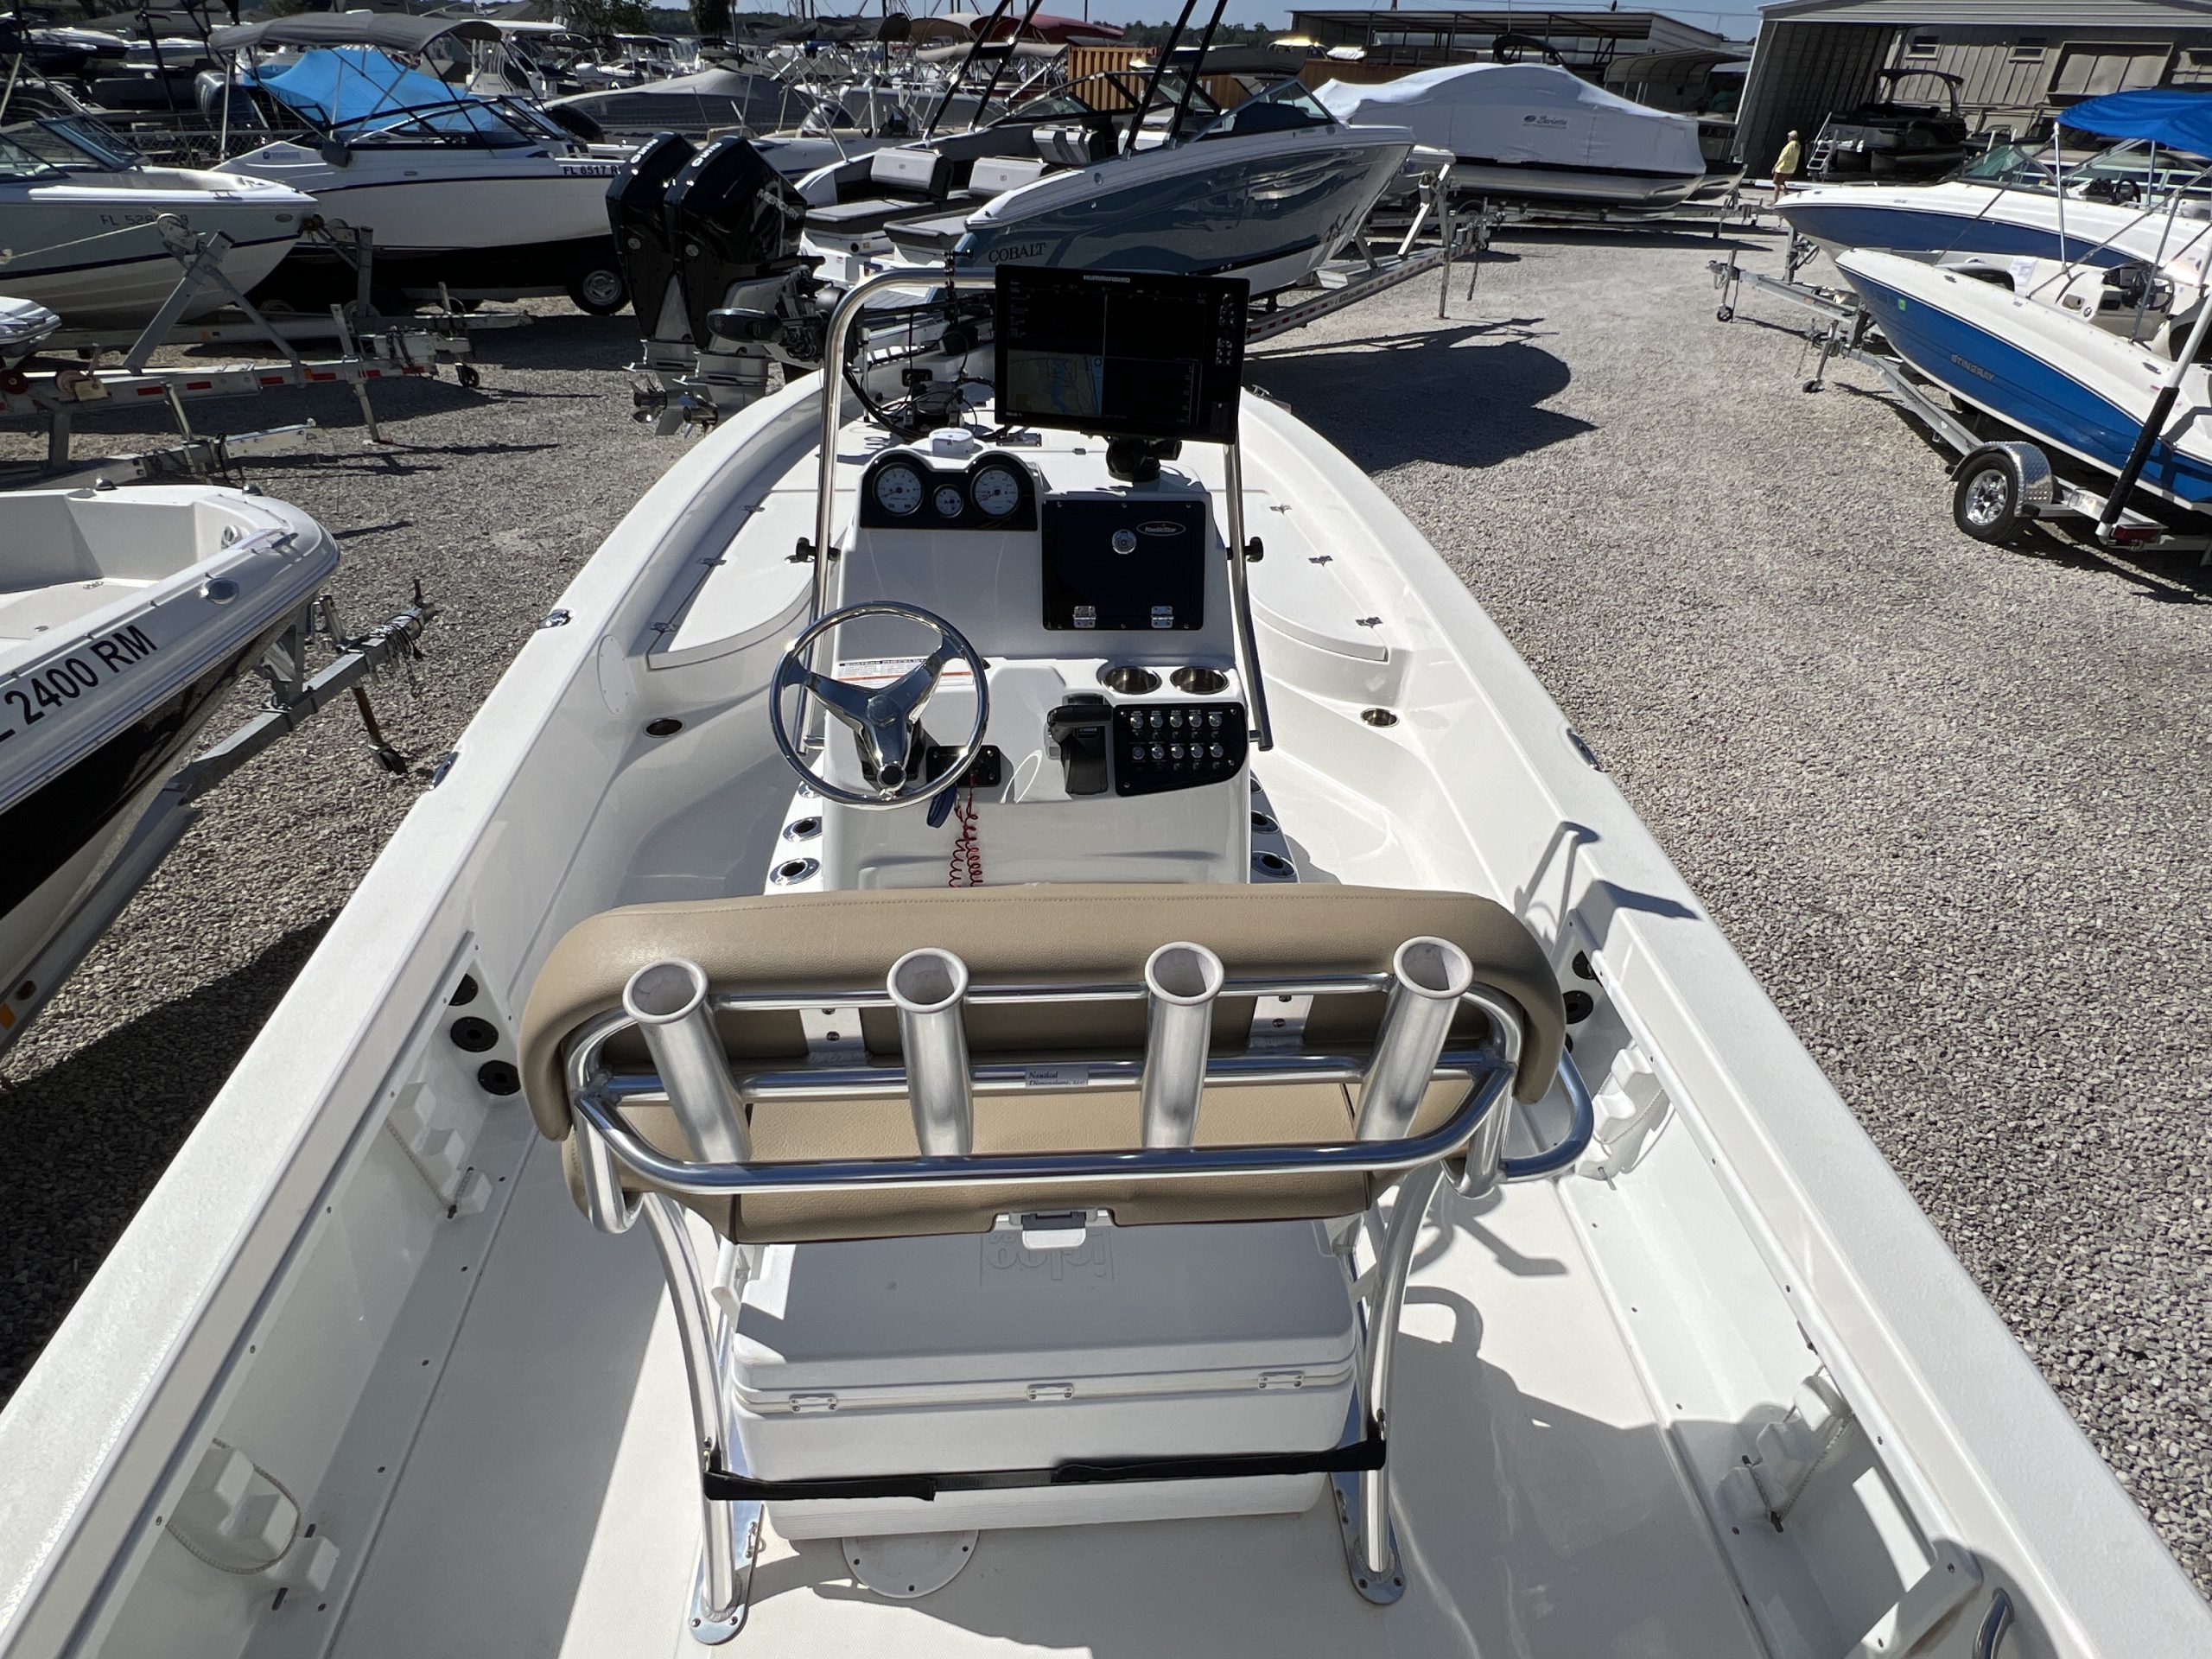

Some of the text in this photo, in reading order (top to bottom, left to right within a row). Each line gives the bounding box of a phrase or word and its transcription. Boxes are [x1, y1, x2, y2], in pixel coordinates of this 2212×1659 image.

[563, 165, 622, 175] FL 6517 R
[100, 214, 118, 226] FL
[988, 243, 1046, 263] COBALT
[4, 625, 157, 725] 2400 RM
